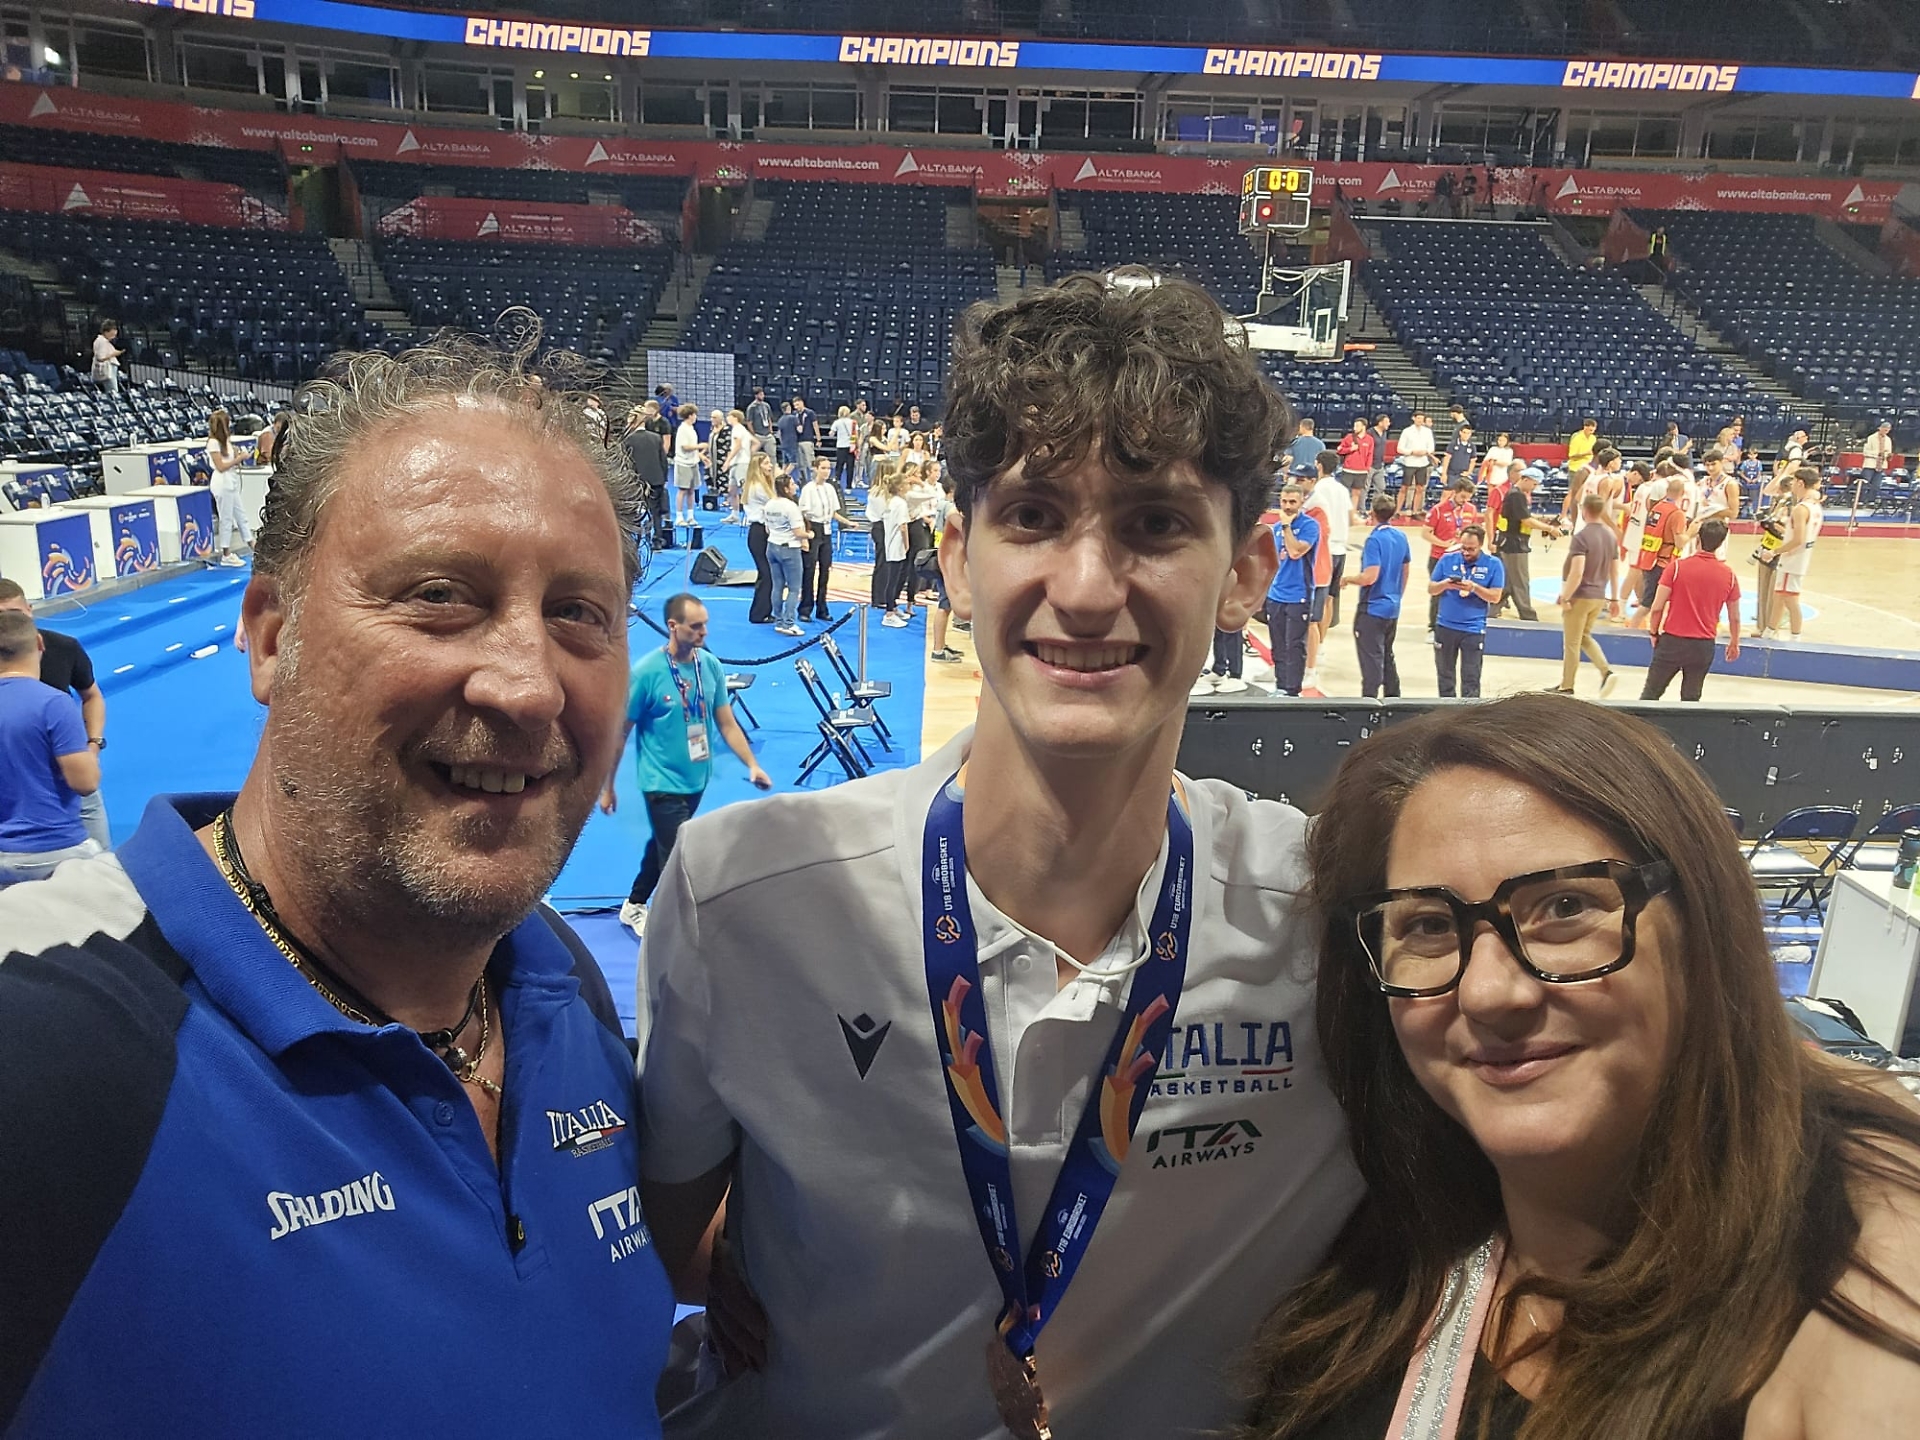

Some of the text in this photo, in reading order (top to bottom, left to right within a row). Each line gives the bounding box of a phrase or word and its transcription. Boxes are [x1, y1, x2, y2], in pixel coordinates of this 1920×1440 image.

[465, 17, 651, 56] CHAMPIONS
[839, 36, 1020, 68] CHAMPIONS
[1202, 48, 1382, 80] CHAMPIONS
[1562, 61, 1739, 91] CHAMPIONS
[421, 142, 491, 153] ALTABANKA
[610, 153, 676, 162] ALTABANKA
[757, 156, 880, 171] www.altabanka.com
[919, 158, 984, 174] ALTABANKA
[1098, 168, 1162, 179] ALTABANKA
[1401, 179, 1436, 189] ALTAB
[1580, 185, 1642, 195] ALTABANKA
[1717, 188, 1832, 201] www.altabanka.com
[939, 836, 951, 893] EUROBASKET
[943, 894, 953, 911] U18
[1164, 1021, 1293, 1070] TALIA
[1150, 1077, 1293, 1097] ASKETBALL
[545, 1099, 627, 1149] ITALIA
[1147, 1119, 1262, 1153] ITA
[1152, 1142, 1255, 1169] AIRWAYS
[267, 1171, 396, 1240] SPALDING
[610, 1225, 652, 1263] AIRWA
